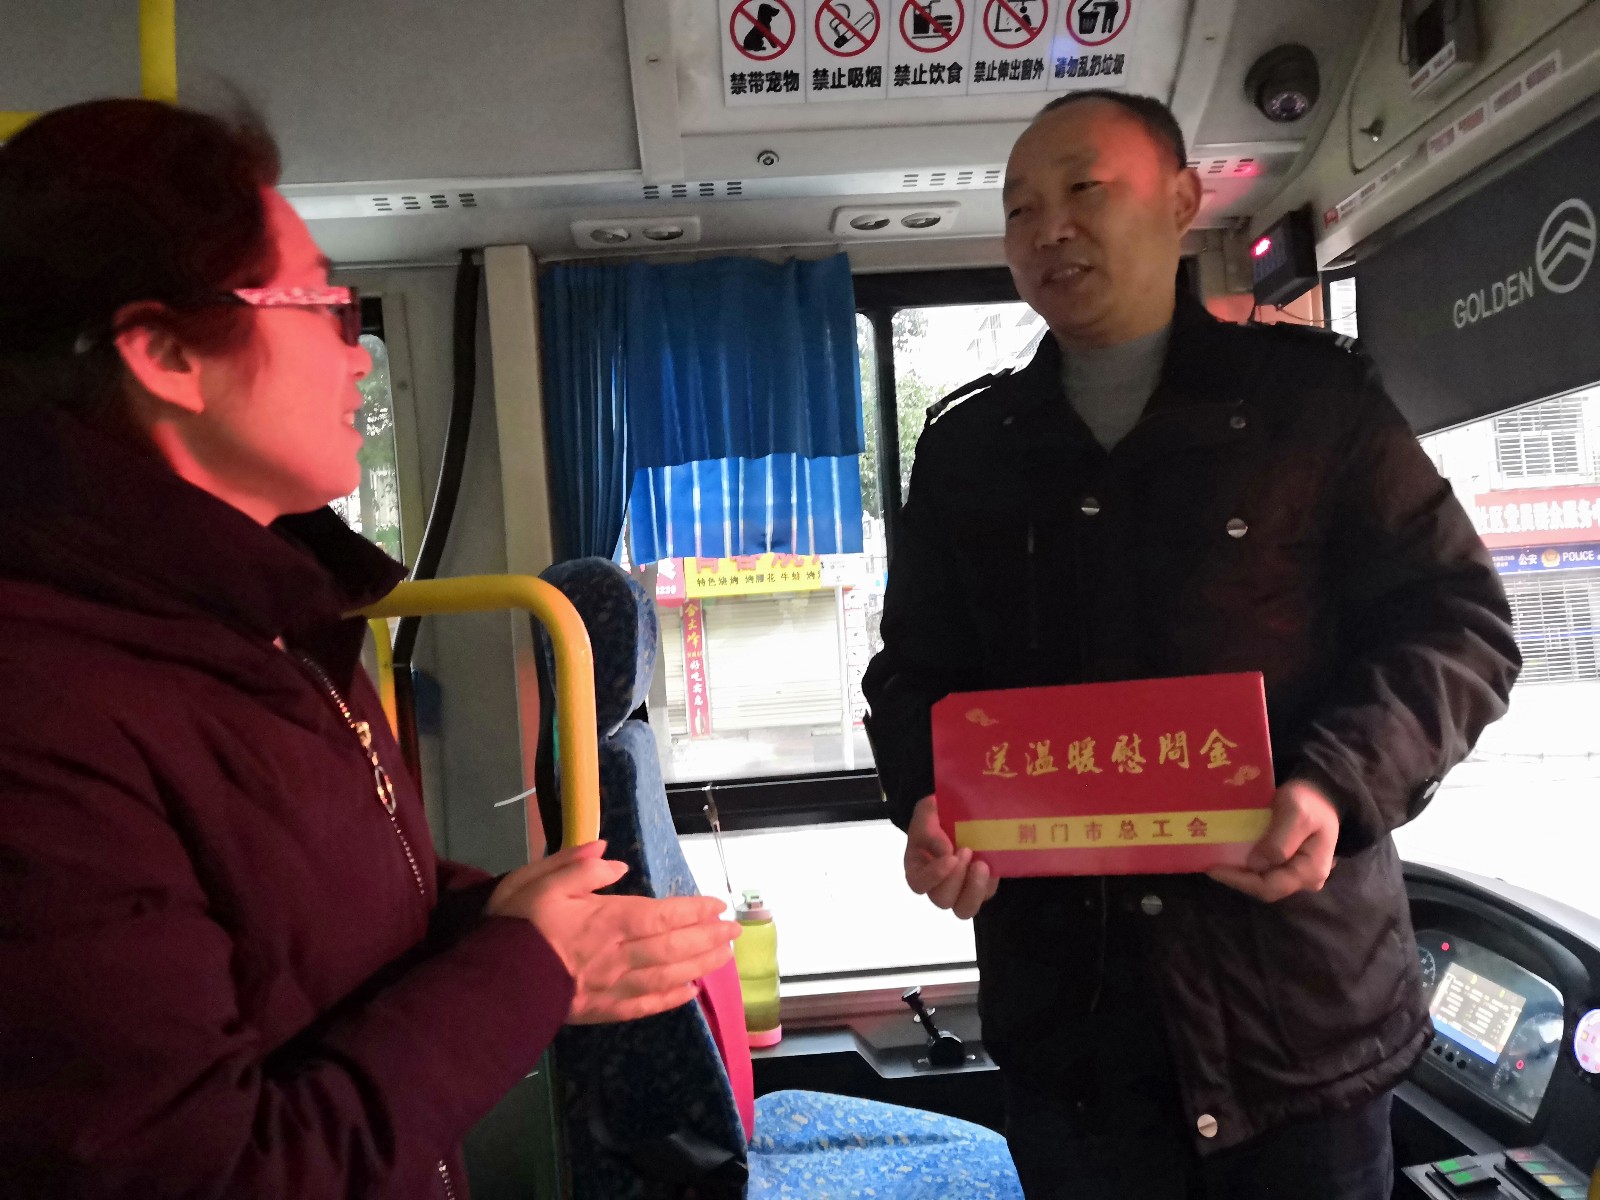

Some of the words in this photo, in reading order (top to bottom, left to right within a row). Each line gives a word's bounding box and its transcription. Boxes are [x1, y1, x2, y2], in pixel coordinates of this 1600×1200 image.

[812, 66, 882, 91] 禁止吸烟
[893, 61, 963, 87] 禁止饮食
[973, 57, 1045, 82] 禁止伸出窗外
[1054, 53, 1126, 79] 请勿乱扔垃圾
[730, 70, 800, 95] 禁带宠物
[1452, 266, 1535, 329] GOLDEN
[1518, 553, 1538, 566] 公安
[1562, 550, 1595, 562] POLICE
[1017, 816, 1209, 844] 荆门市总工会
